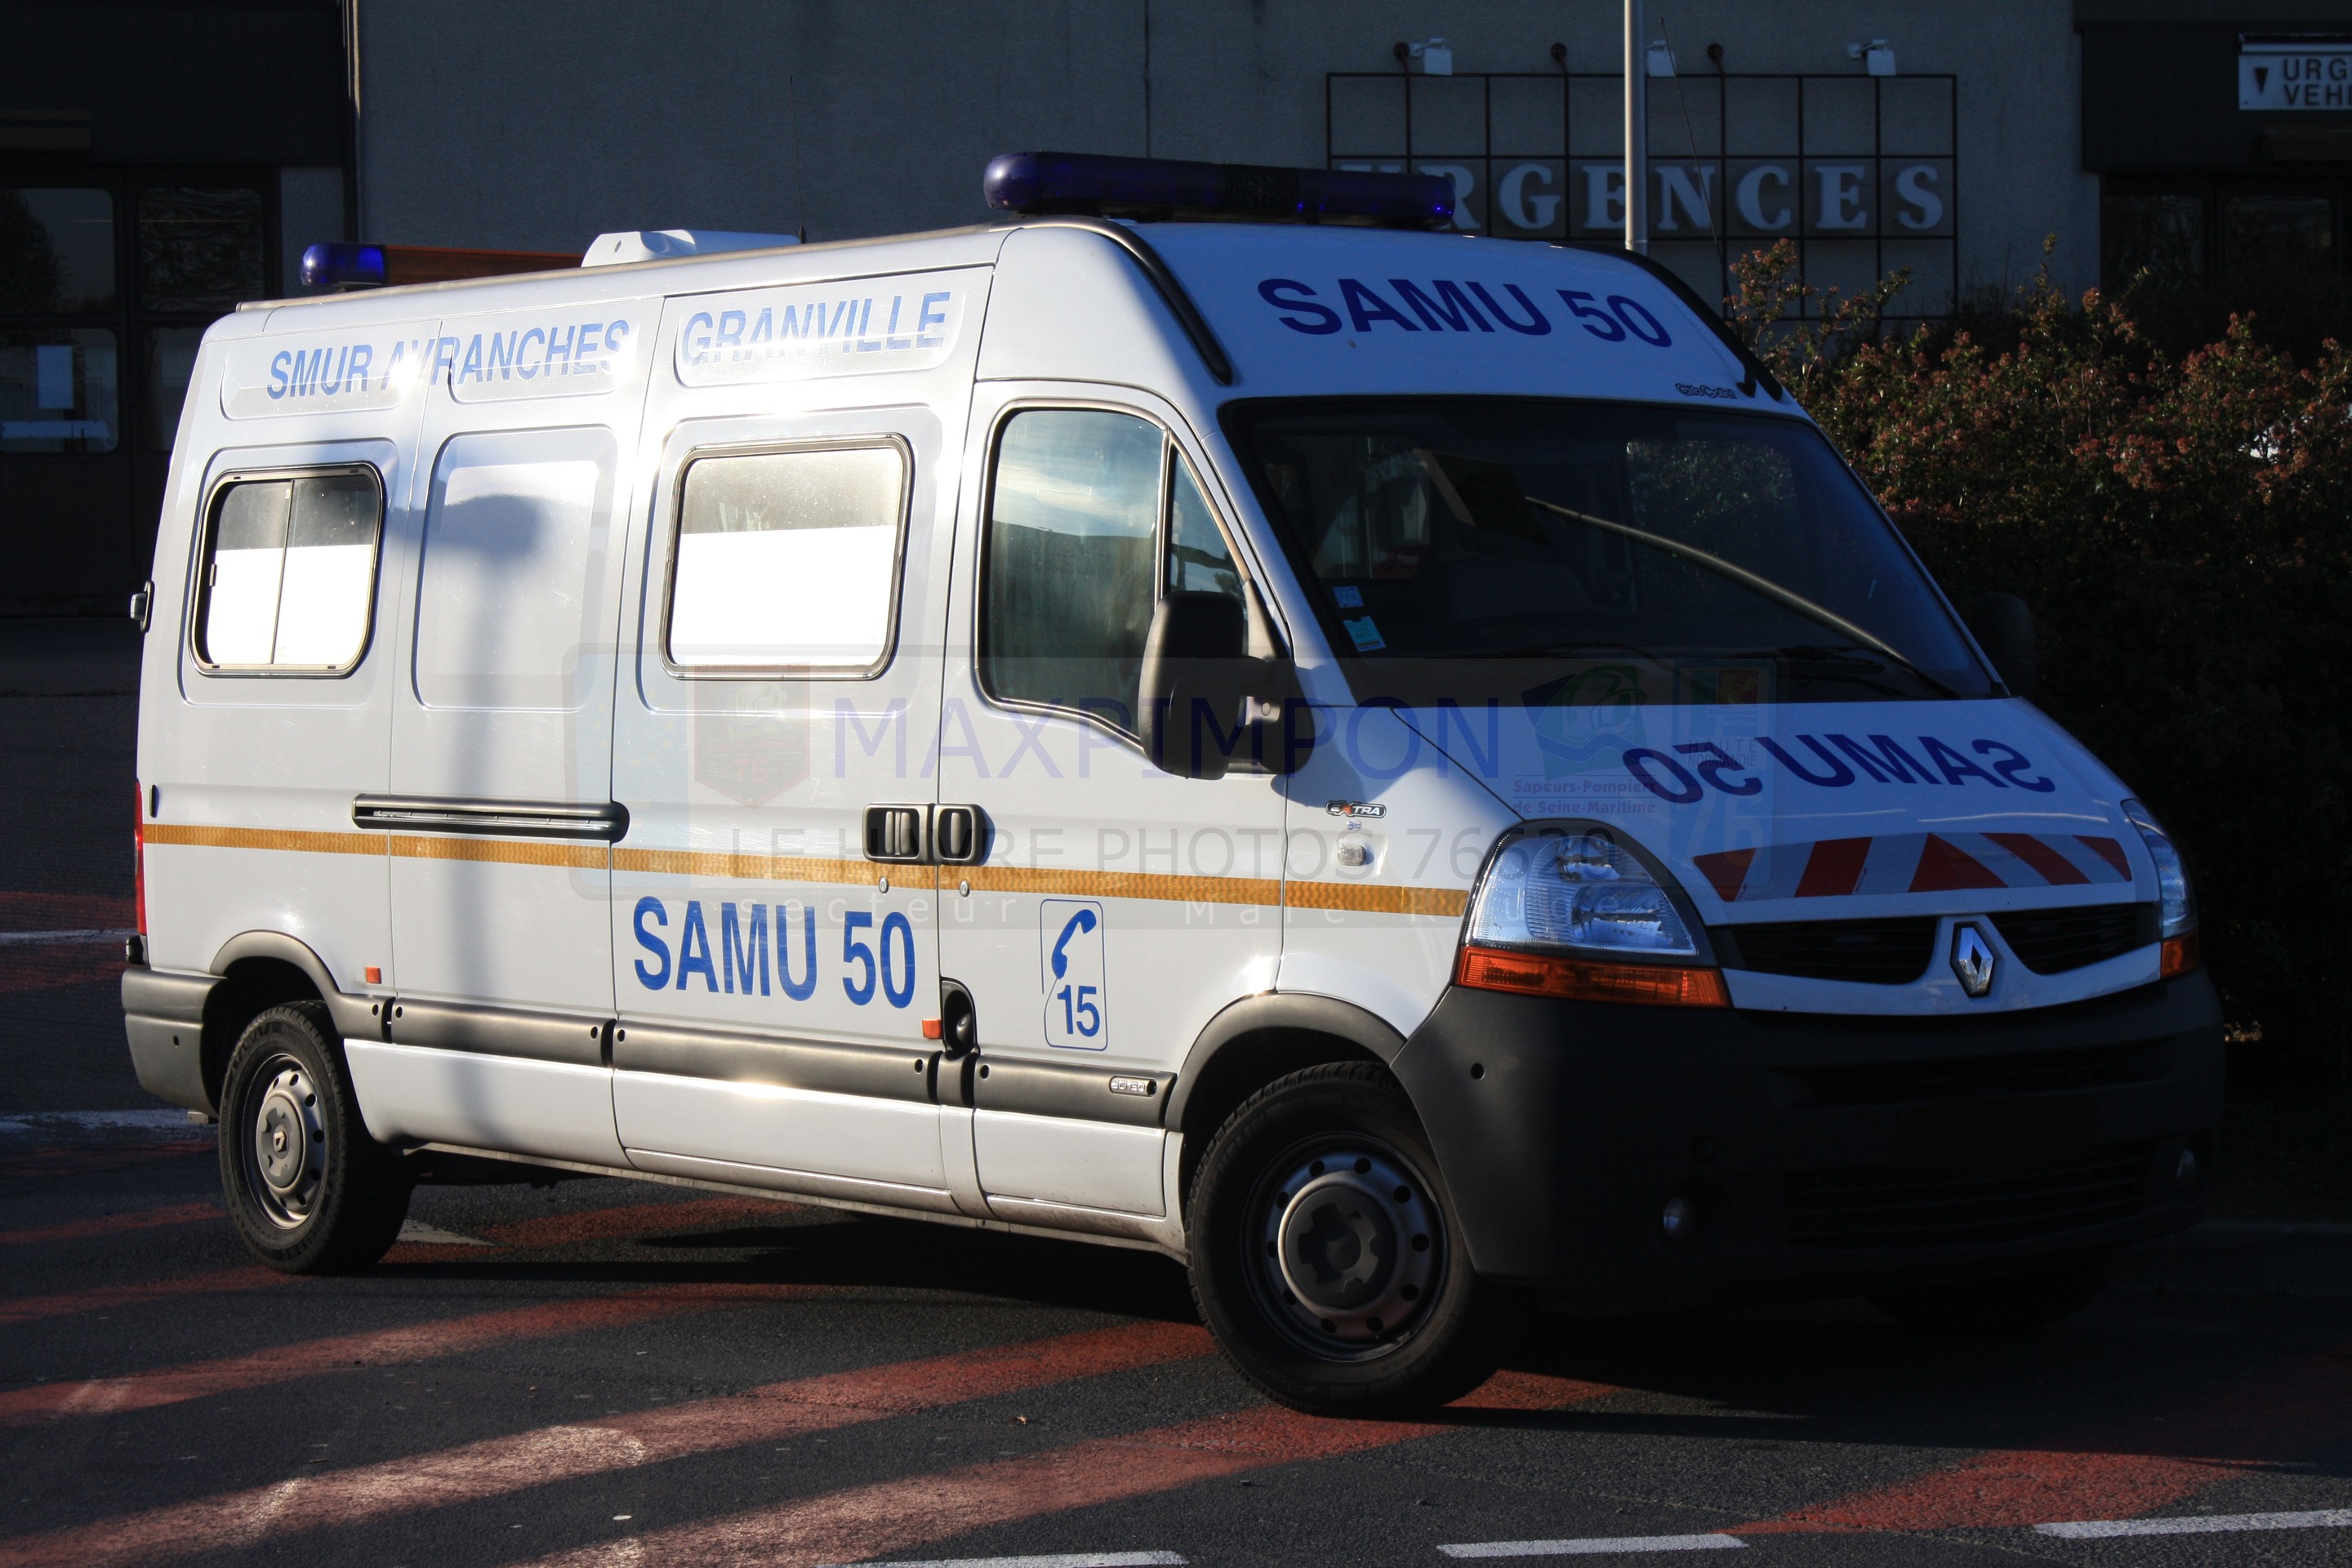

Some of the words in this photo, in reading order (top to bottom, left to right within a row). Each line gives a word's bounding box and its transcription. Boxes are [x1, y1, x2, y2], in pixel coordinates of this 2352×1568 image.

[681, 291, 952, 367] GRANVILLE
[1258, 278, 1552, 336] SAMU
[1557, 289, 1673, 349] 50
[267, 344, 373, 400] SMUR
[381, 319, 630, 391] AVRANCHES
[1330, 804, 1380, 816] EXTRA
[633, 896, 817, 1002] SAMU
[842, 910, 916, 1009] 50
[1057, 984, 1101, 1038] 15
